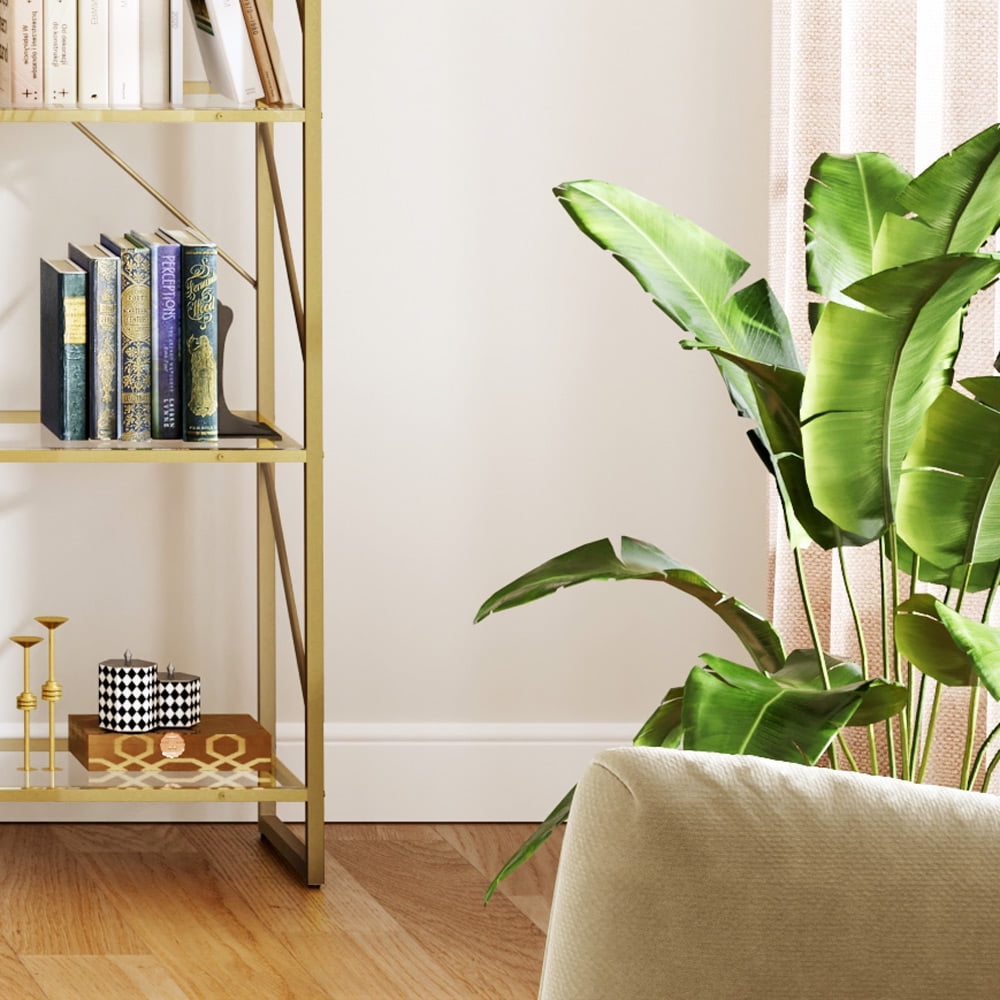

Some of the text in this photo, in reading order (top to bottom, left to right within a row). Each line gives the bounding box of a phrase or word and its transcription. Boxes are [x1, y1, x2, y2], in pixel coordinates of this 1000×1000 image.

[51, 31, 59, 68] konstrukcji
[60, 35, 68, 66] dekoracji
[162, 255, 176, 321] PERCEPTIONS
